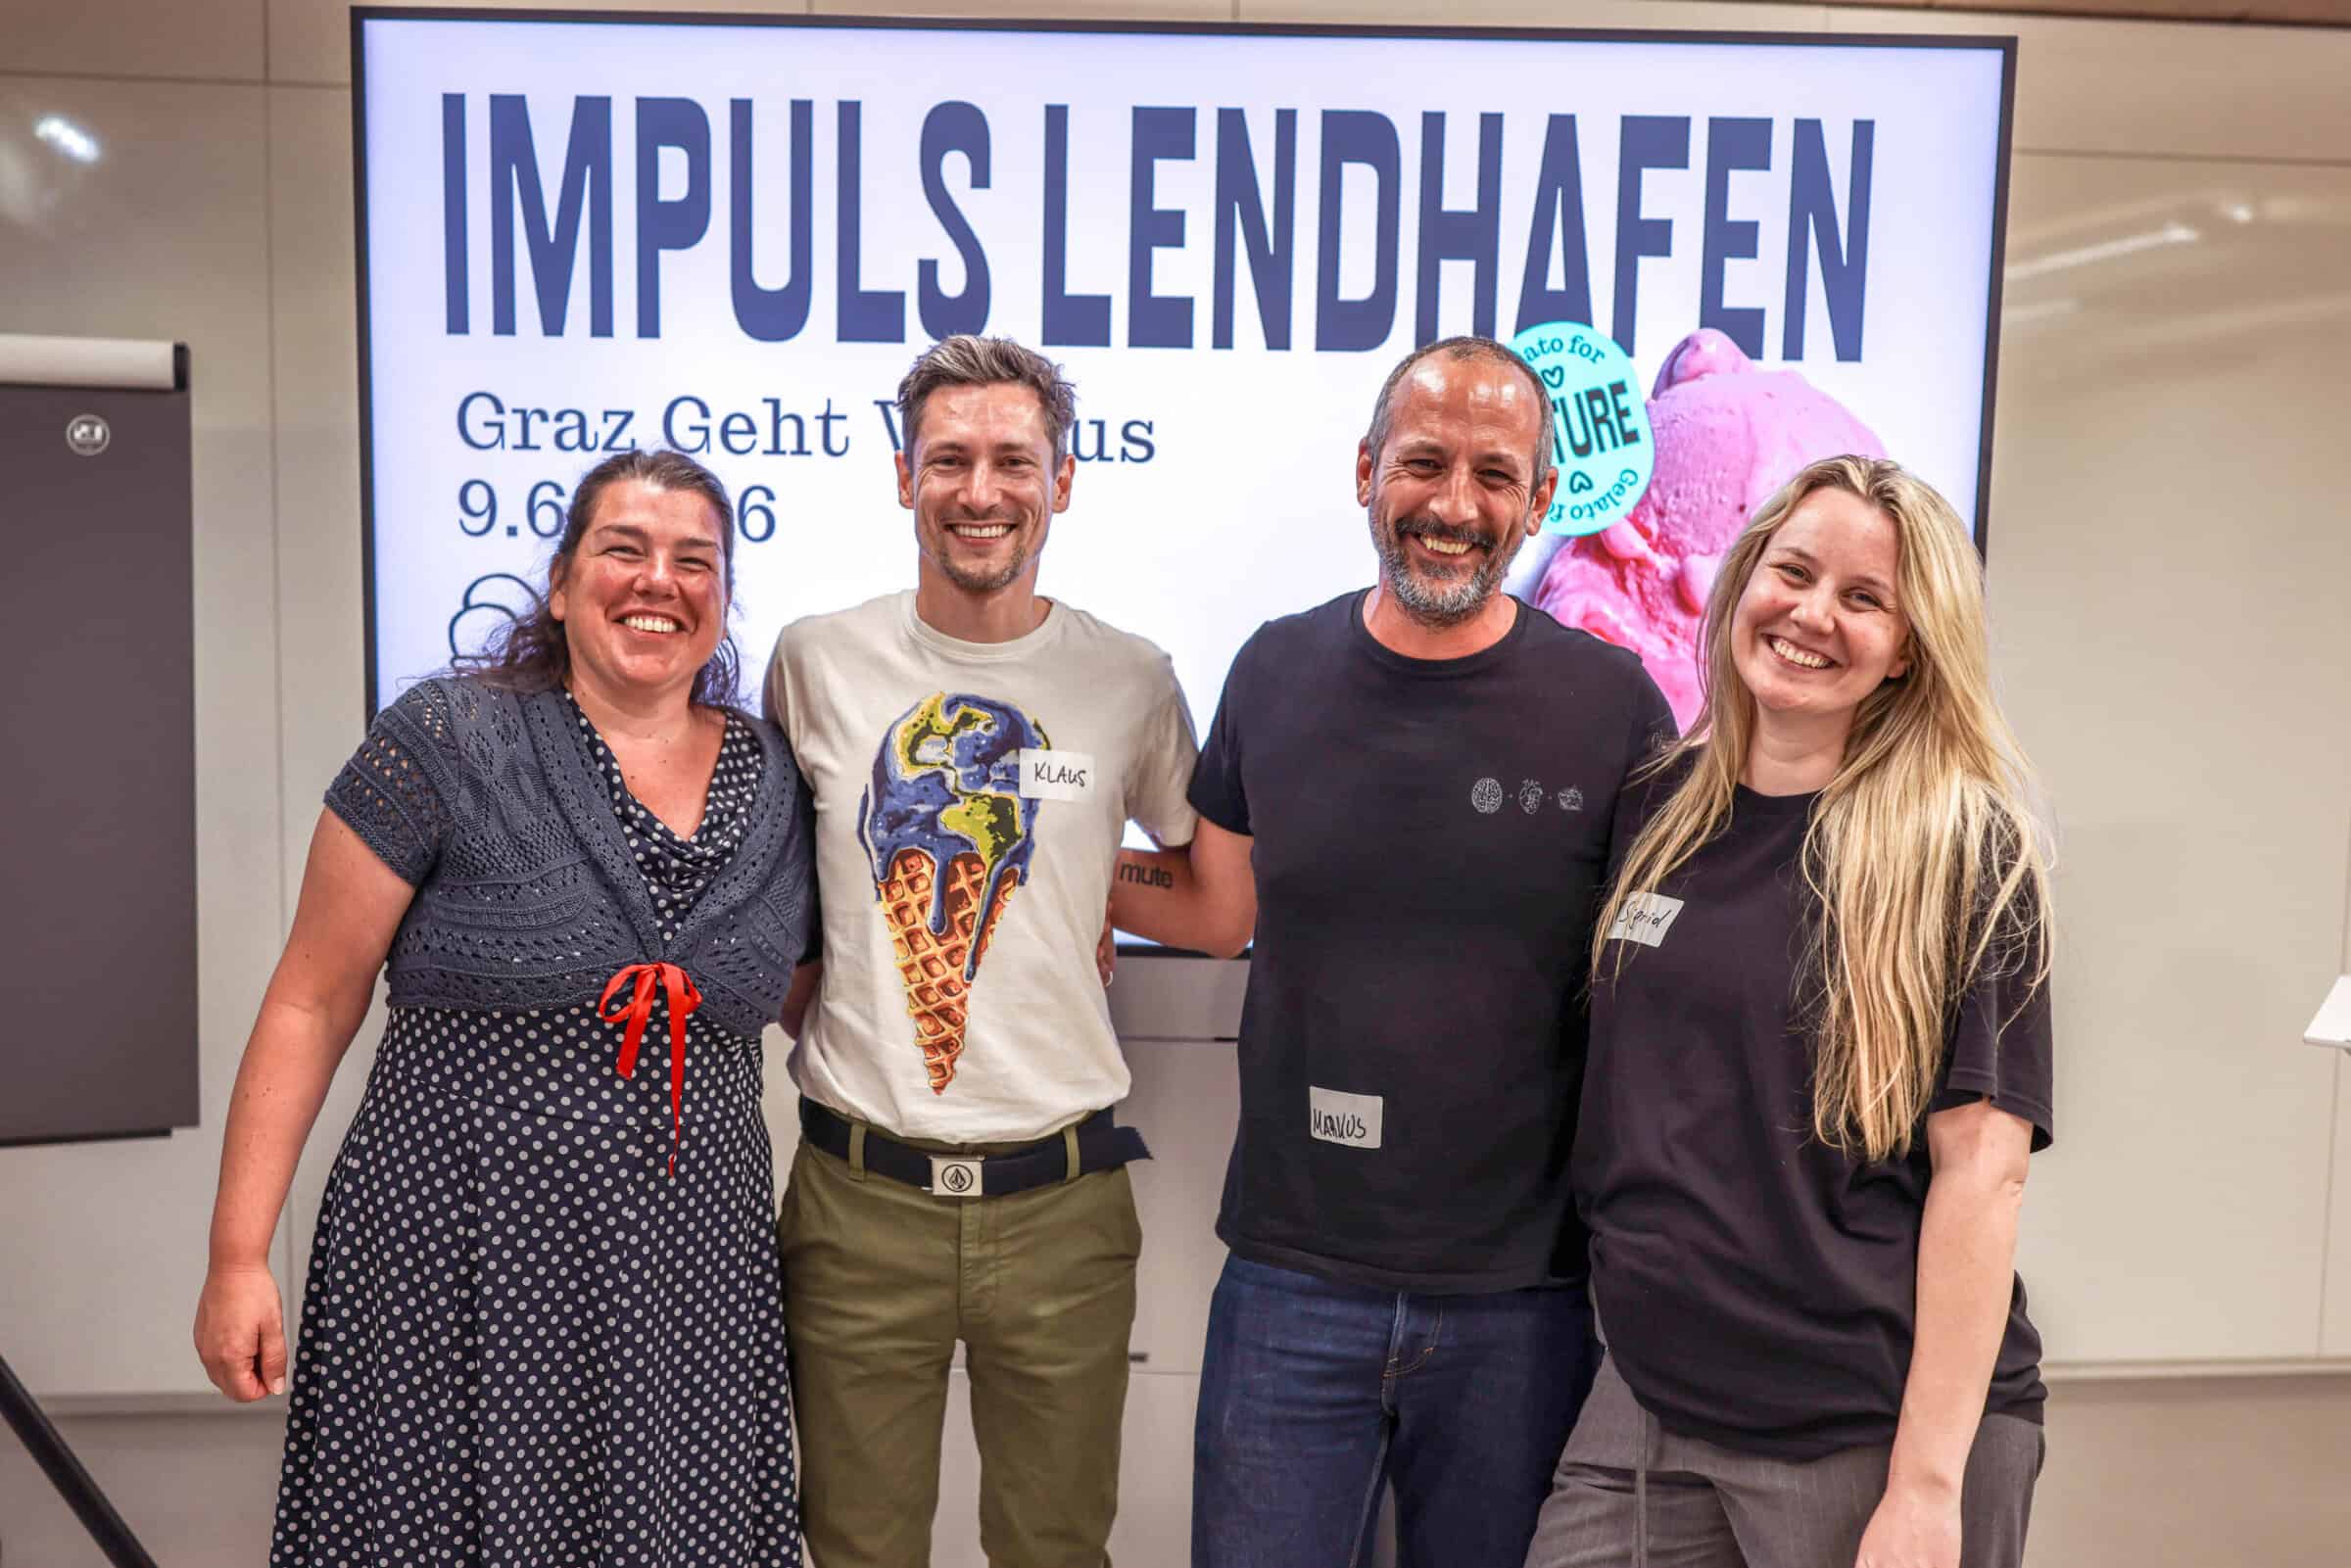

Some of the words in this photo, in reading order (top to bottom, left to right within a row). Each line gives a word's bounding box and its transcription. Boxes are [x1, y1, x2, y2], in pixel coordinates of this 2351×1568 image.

[442, 92, 992, 343] IMPULS
[1041, 104, 1875, 362] LENDHAFEN
[1567, 335, 1606, 364] for
[456, 391, 638, 452] Graz
[662, 395, 850, 457] Geht
[1569, 468, 1639, 521] Gelato
[1120, 861, 1174, 888] mute
